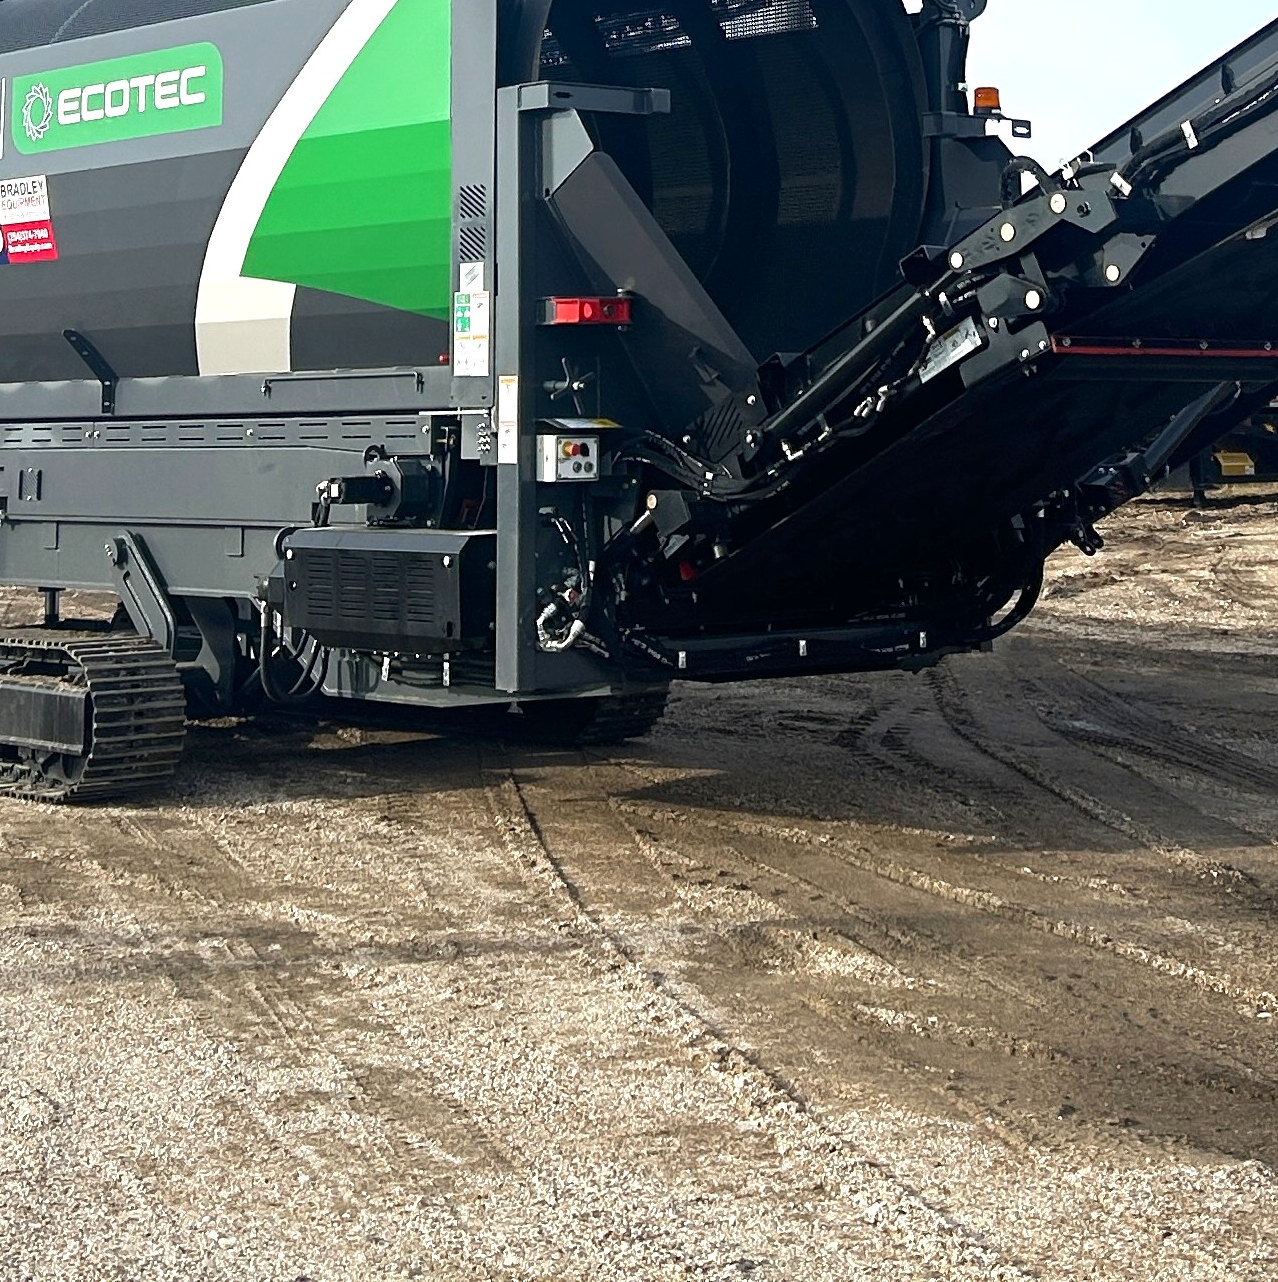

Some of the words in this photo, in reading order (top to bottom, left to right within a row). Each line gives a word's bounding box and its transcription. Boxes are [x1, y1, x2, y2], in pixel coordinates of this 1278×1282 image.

[57, 65, 206, 125] ECOTEC
[0, 180, 44, 198] BRADLEY
[1, 195, 46, 210] EQUIPMENT
